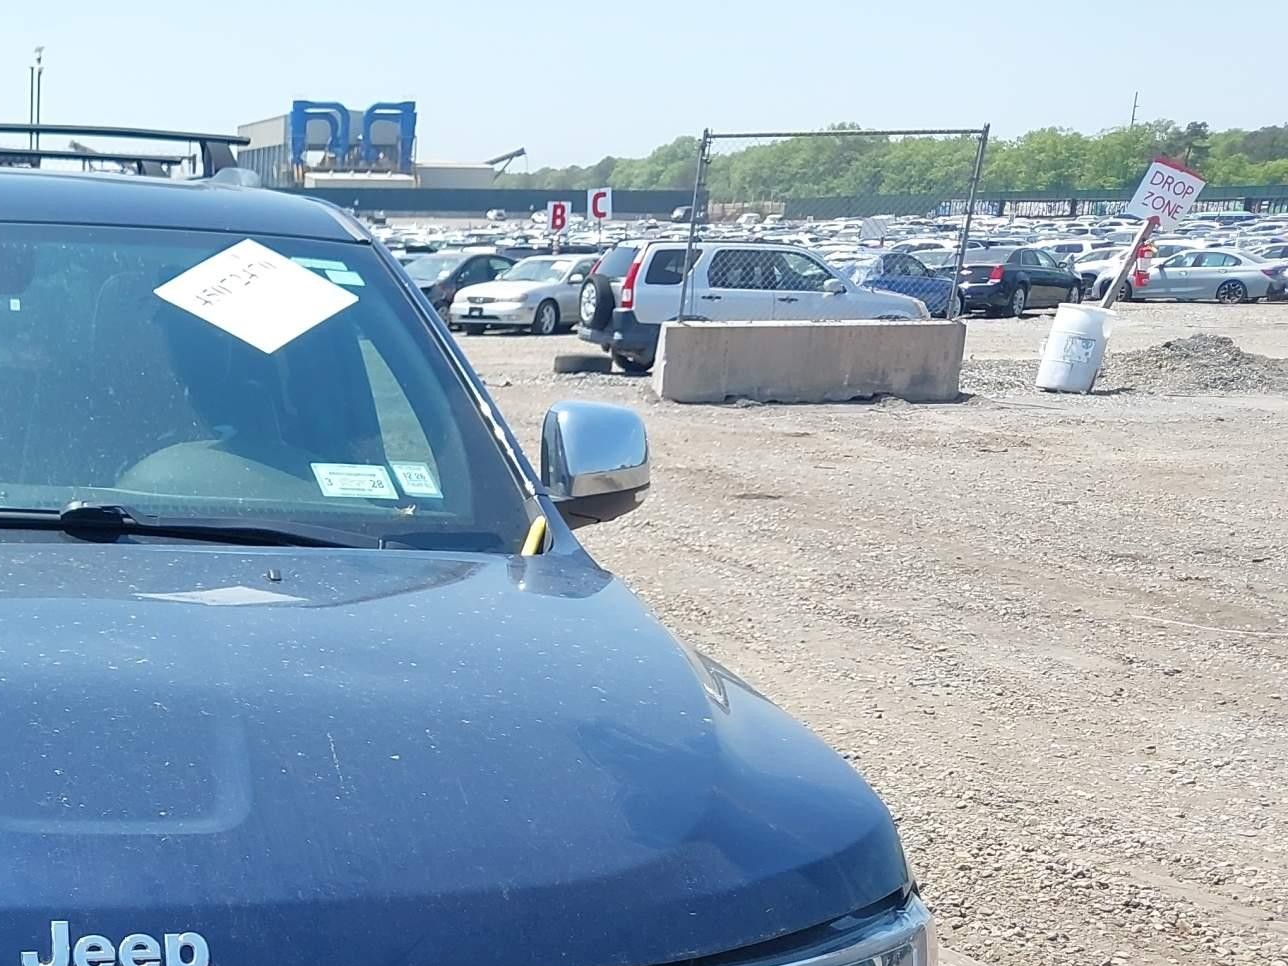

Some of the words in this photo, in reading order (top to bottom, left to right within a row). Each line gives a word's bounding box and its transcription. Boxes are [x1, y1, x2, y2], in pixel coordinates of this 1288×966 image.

[1150, 170, 1194, 199] DROP
[551, 204, 566, 230] B
[592, 191, 607, 218] C
[1141, 191, 1184, 220] ZONE
